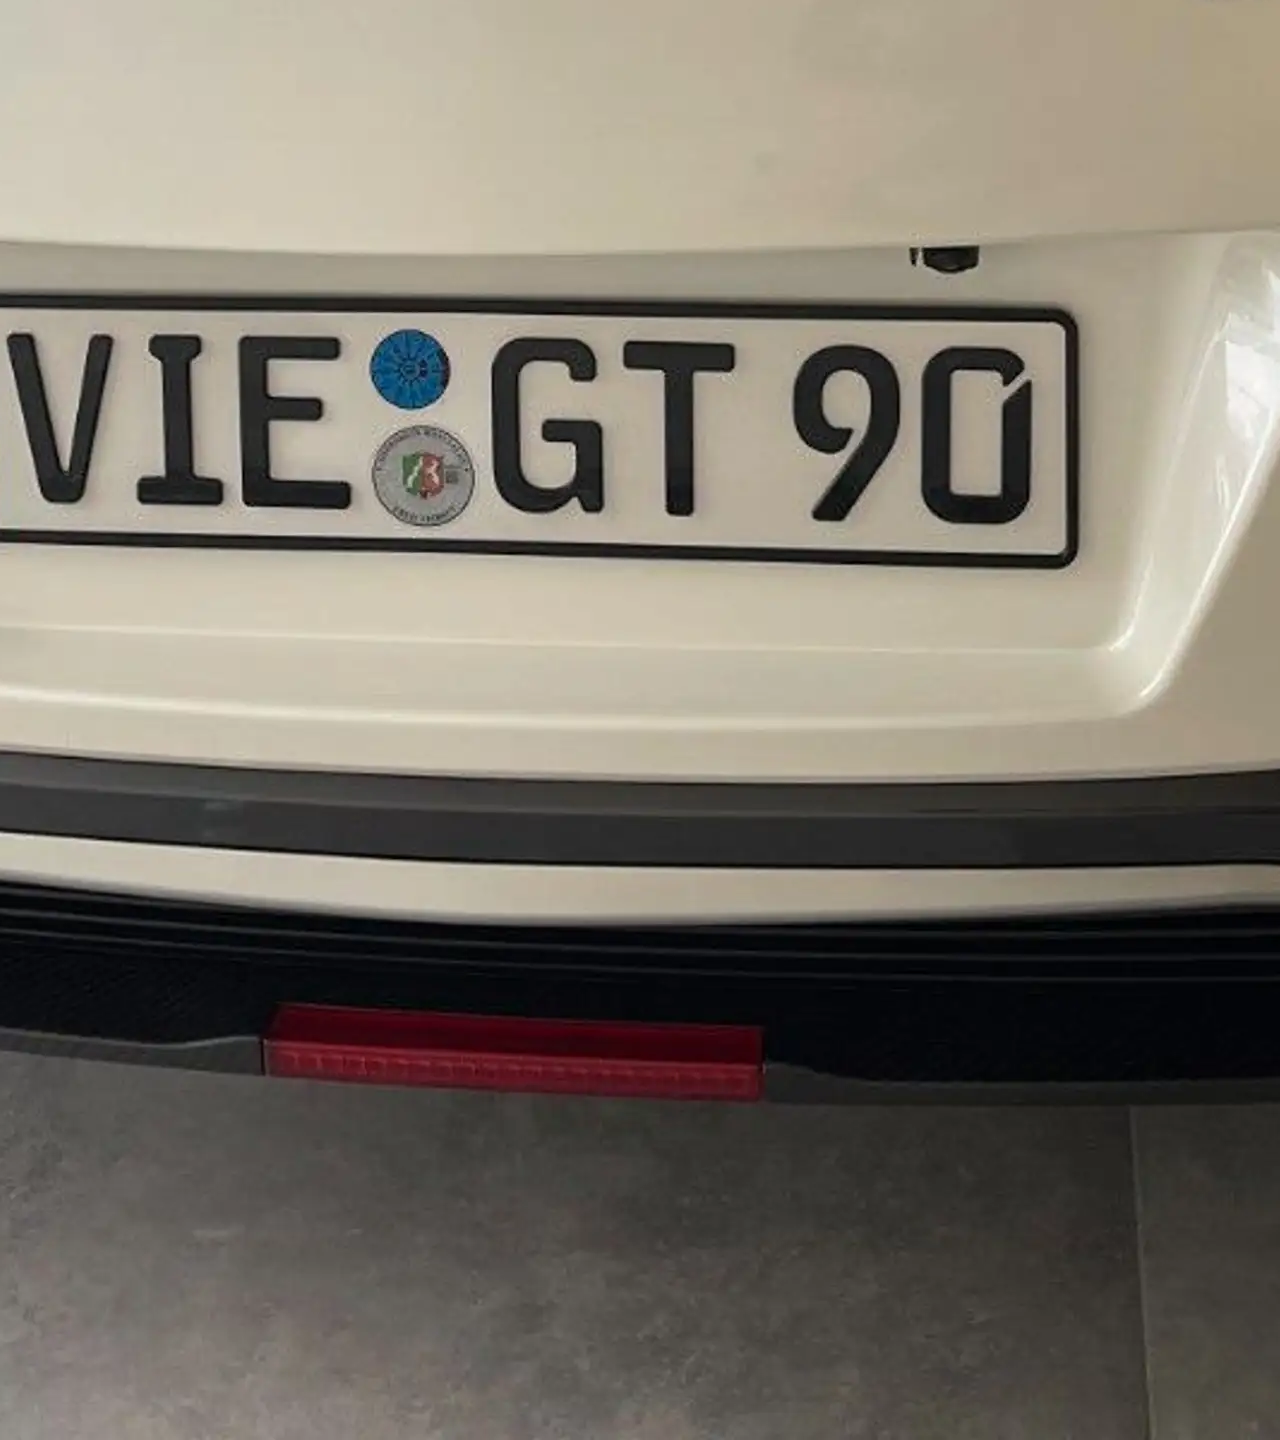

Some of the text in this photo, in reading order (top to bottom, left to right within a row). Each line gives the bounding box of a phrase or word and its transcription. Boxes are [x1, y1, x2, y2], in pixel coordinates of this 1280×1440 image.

[6, 333, 353, 509] VIE
[490, 336, 737, 517] GT
[792, 344, 1031, 526] 90
